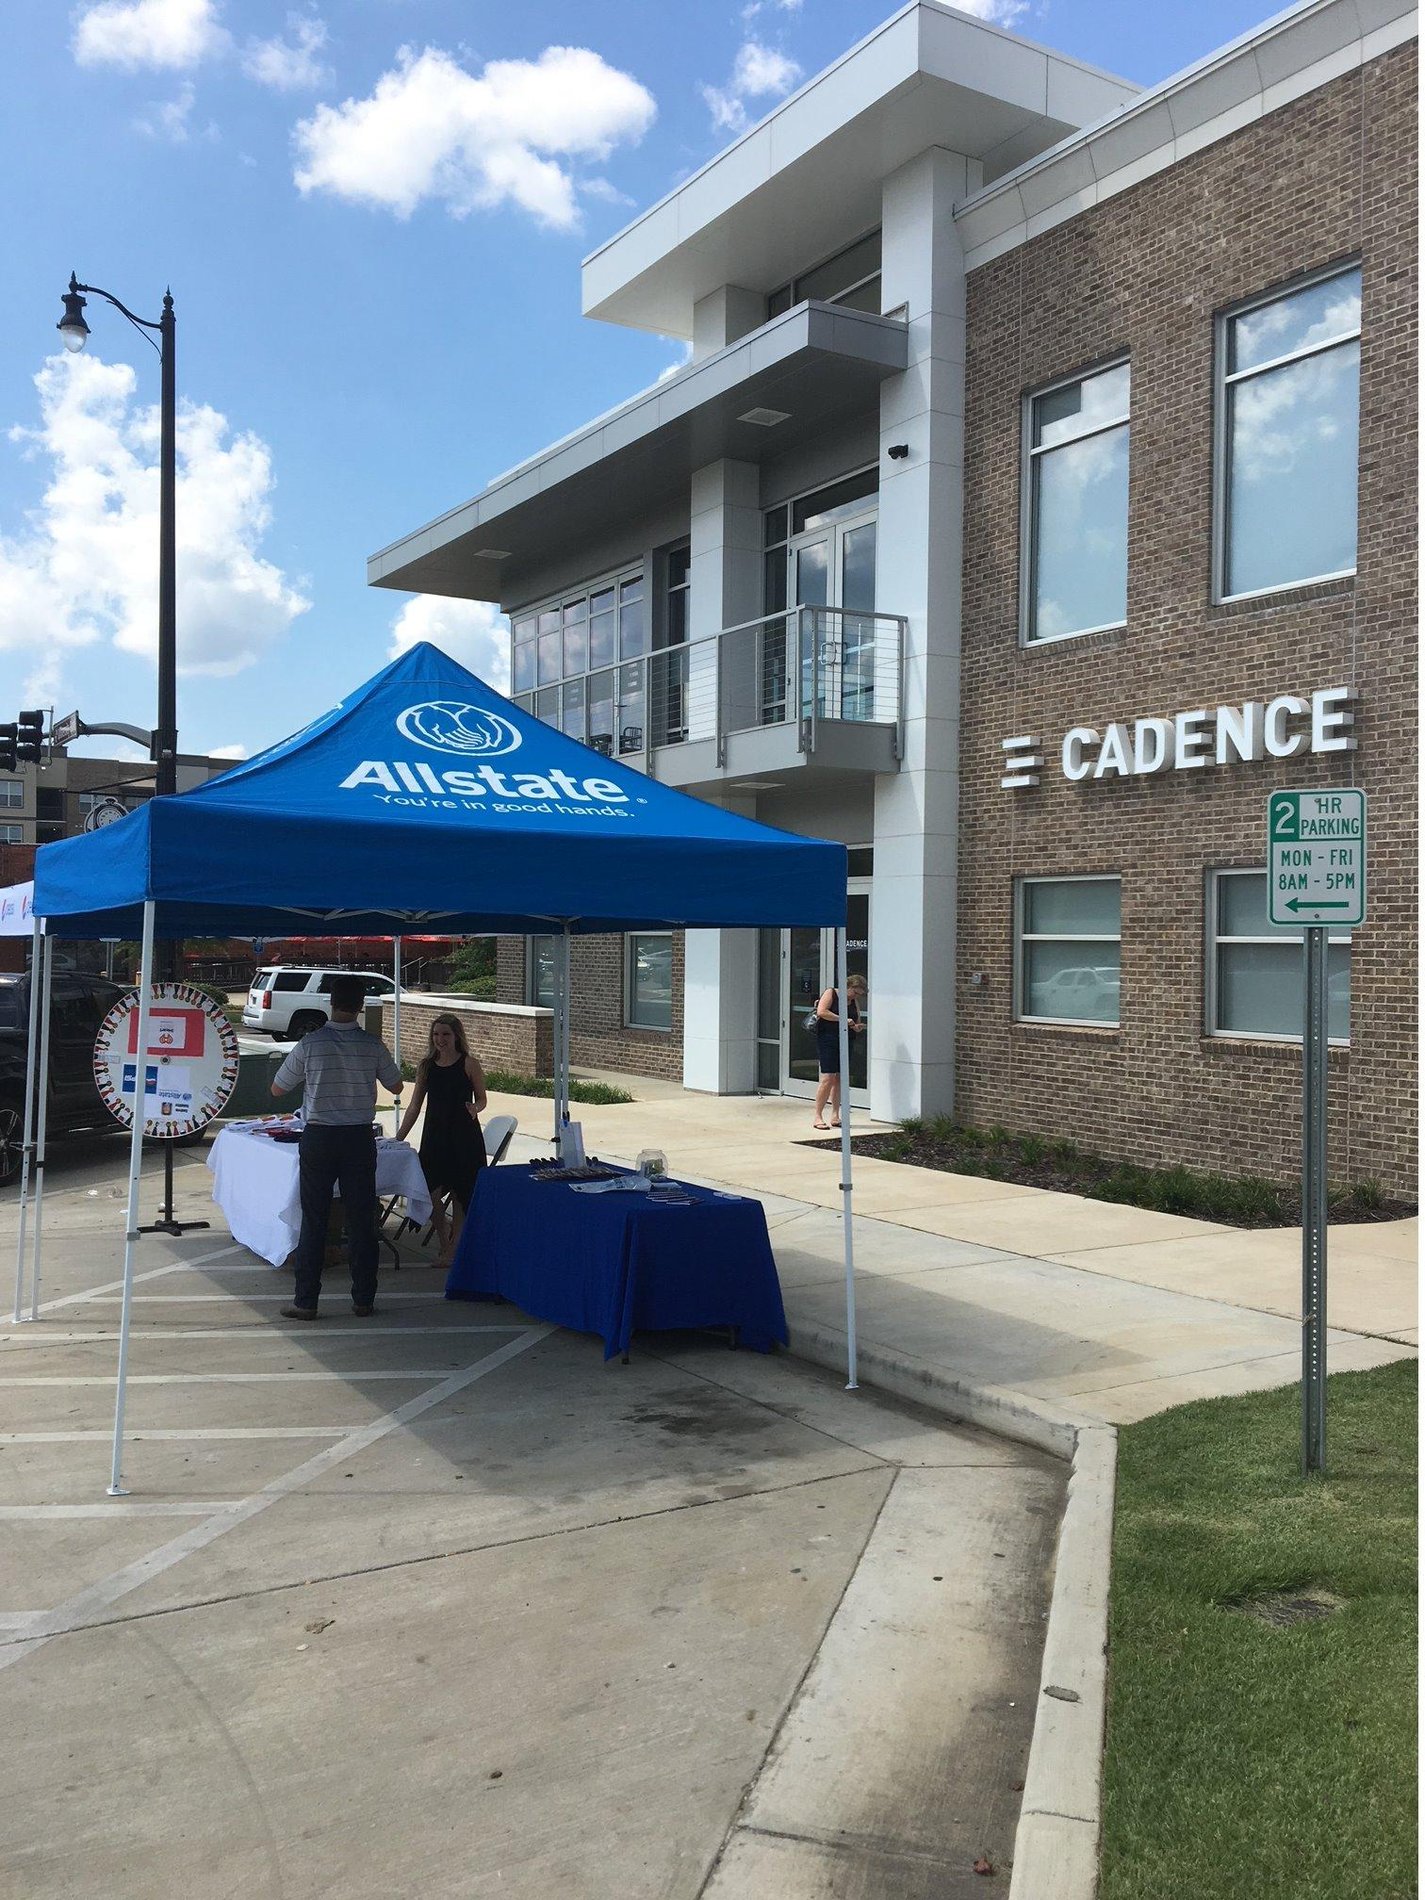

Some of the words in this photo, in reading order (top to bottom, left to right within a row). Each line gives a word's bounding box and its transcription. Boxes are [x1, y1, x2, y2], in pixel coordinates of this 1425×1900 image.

[1062, 686, 1359, 781] CADENCE
[338, 760, 630, 802] Allstate
[372, 794, 457, 811] You're
[461, 799, 486, 810] in
[493, 800, 553, 814] good
[559, 803, 635, 818] hands.
[1318, 798, 1342, 813] HR
[1274, 801, 1295, 834] 2
[1301, 817, 1360, 836] PARKING
[1281, 850, 1312, 866] MON
[1330, 849, 1353, 865] FRI
[1279, 874, 1309, 890] 8AM
[1326, 873, 1355, 890] 5PM
